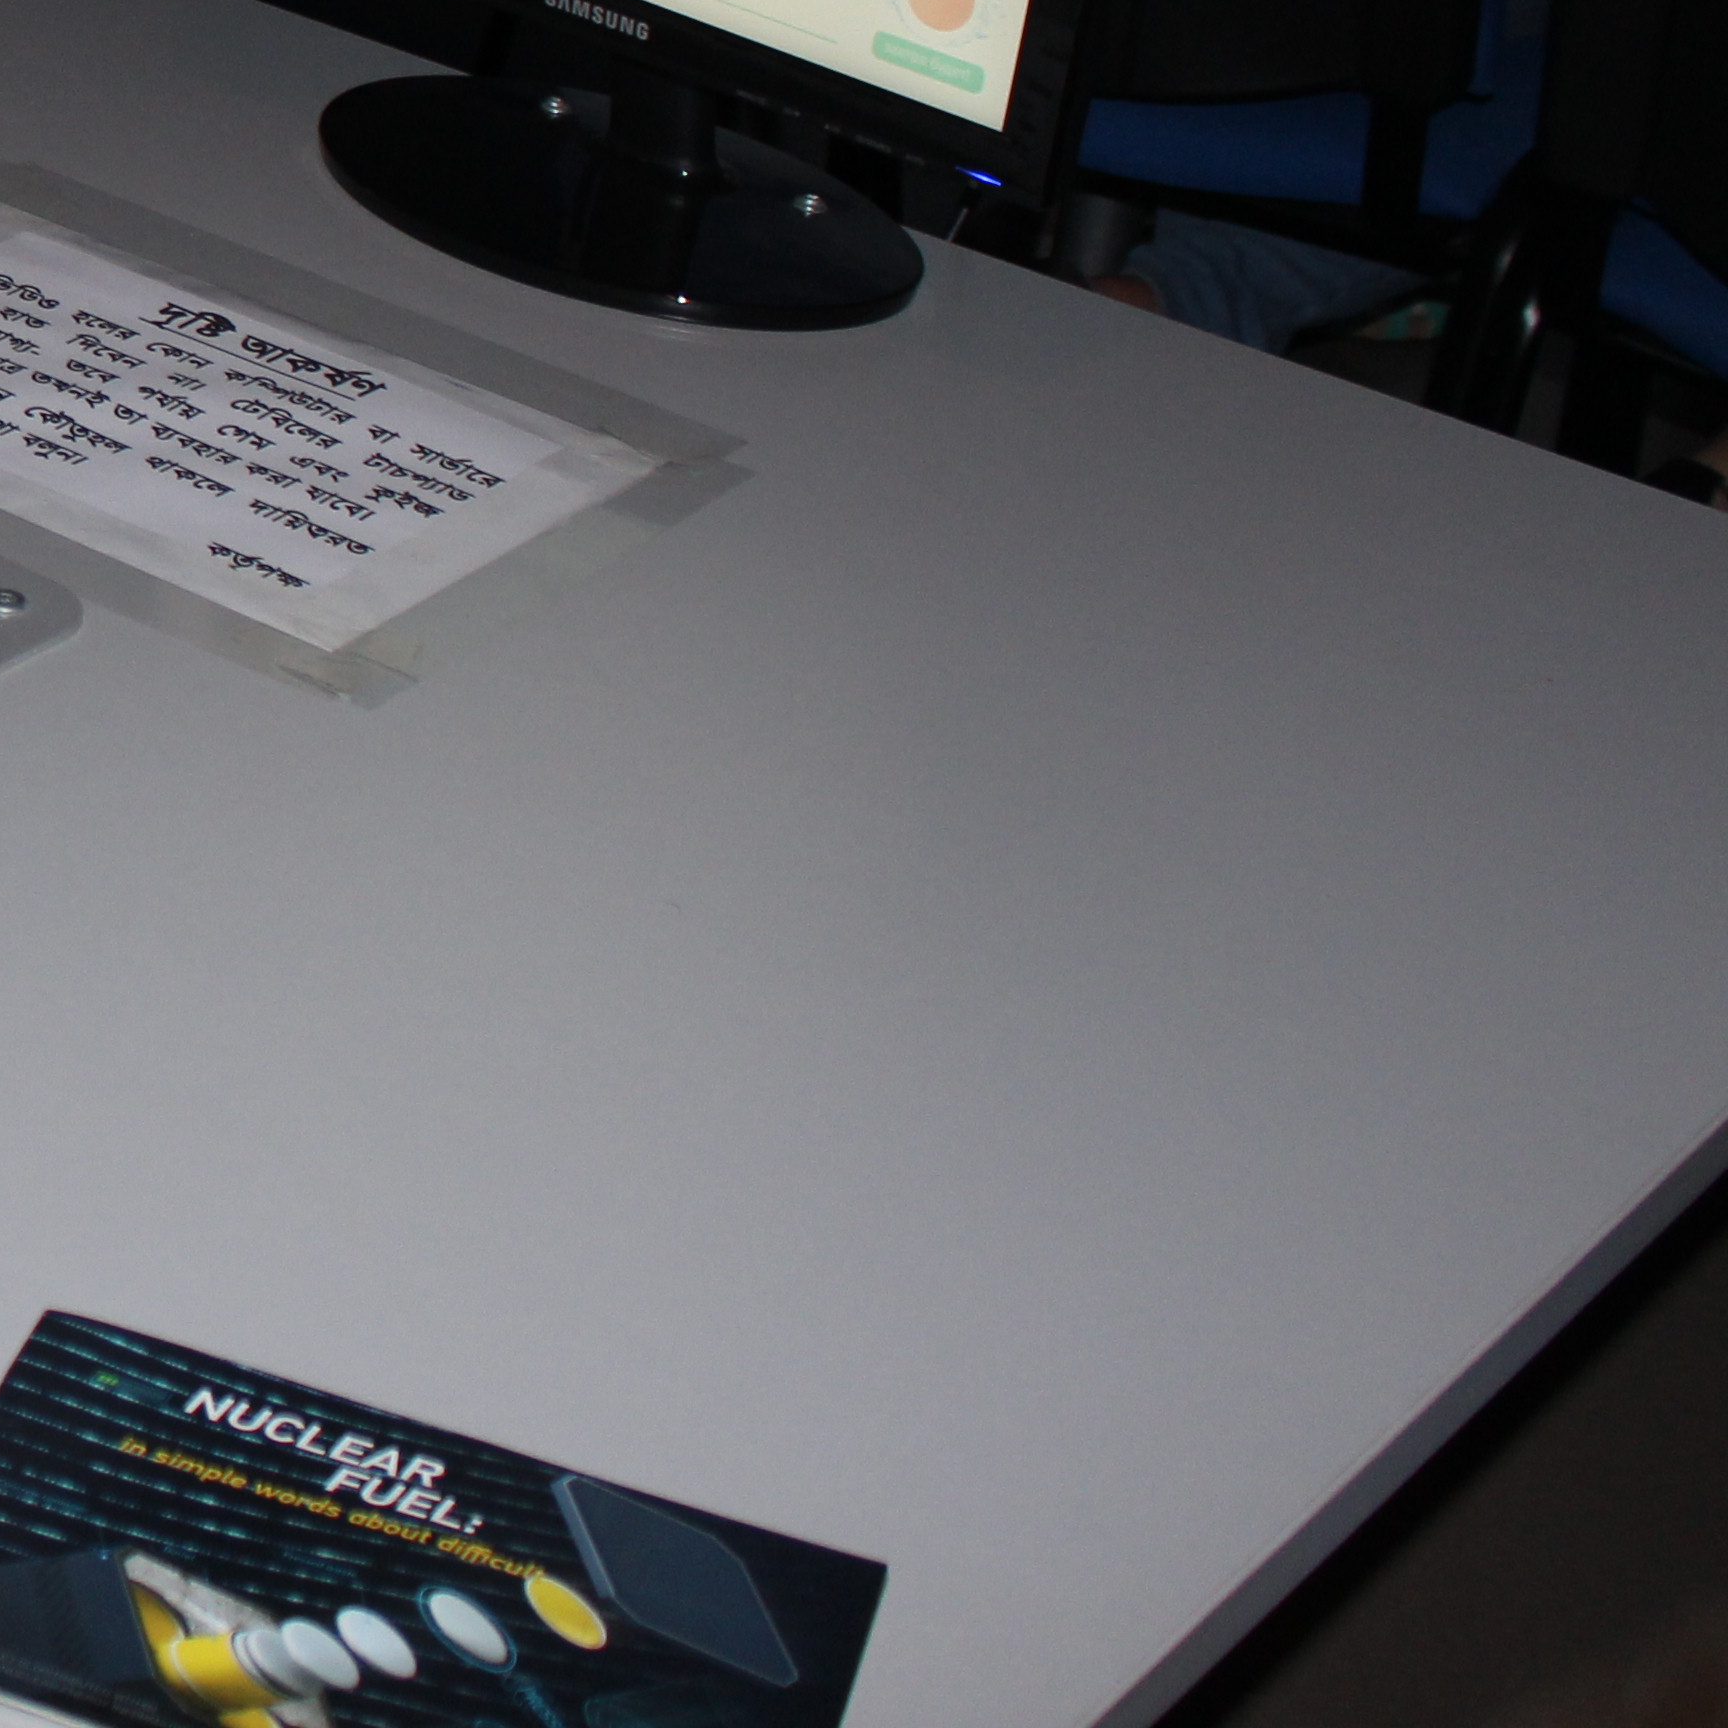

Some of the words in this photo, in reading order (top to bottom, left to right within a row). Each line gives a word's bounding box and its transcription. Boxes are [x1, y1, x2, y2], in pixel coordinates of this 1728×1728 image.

[0, 306, 51, 329] হাত
[66, 333, 148, 369] দিবেন
[229, 397, 343, 450] টেবিলের
[71, 309, 141, 341] হলের
[146, 342, 214, 370] কোন
[367, 423, 402, 444] বা
[410, 443, 507, 489] সার্ভারে
[155, 301, 237, 339] দৃষ্টি
[241, 334, 389, 399] আকর্ষণ
[30, 370, 112, 409] তখনই
[113, 403, 149, 425] তা
[151, 422, 244, 467] ব্যবহার
[245, 461, 303, 489] করা
[66, 359, 122, 384] তবে
[217, 423, 277, 450] গেম
[290, 454, 350, 483] এবং
[364, 484, 446, 519] কুইজ
[145, 455, 236, 497] থাকলে
[118, 1436, 148, 1456] in
[152, 1448, 248, 1489] simple
[254, 1482, 343, 1518] words
[347, 1509, 433, 1544] about
[183, 1386, 446, 1488] NUCLEAR
[324, 1466, 484, 1535] FUEL:
